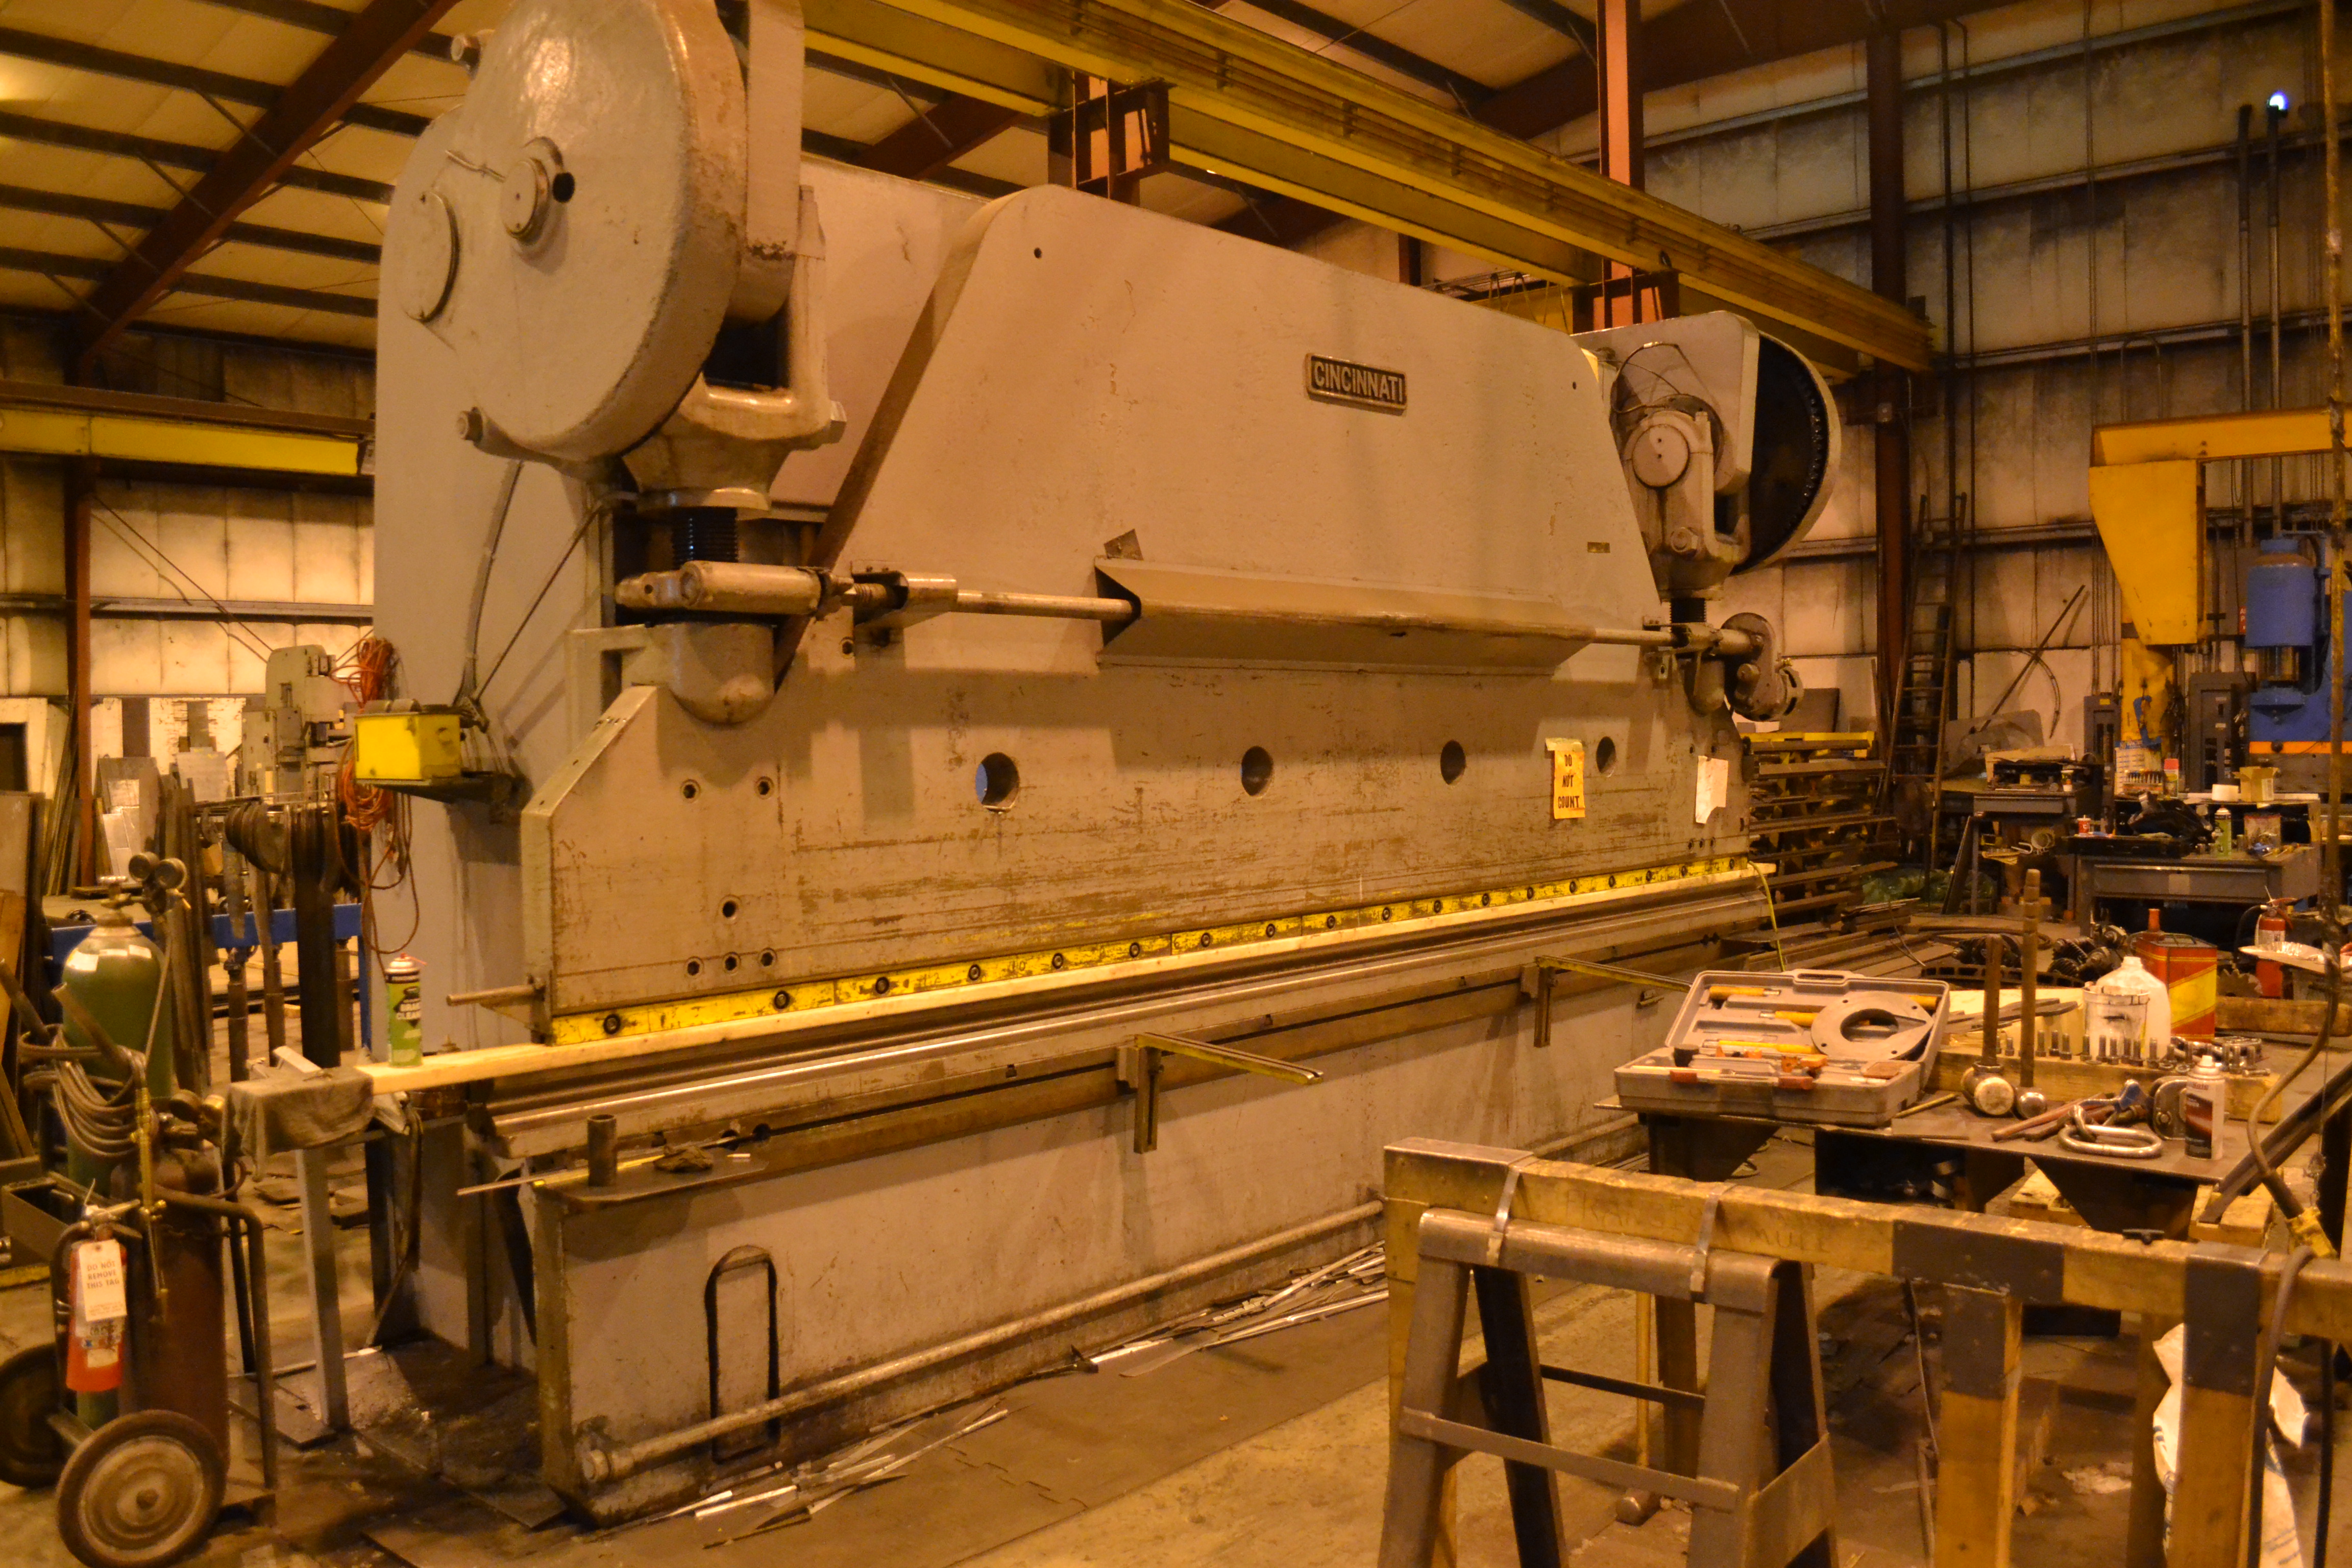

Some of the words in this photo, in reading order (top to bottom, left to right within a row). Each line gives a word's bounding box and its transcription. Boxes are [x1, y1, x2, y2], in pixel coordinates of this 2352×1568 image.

[1314, 361, 1403, 403] CINCINNATI
[1564, 754, 1572, 767] DO
[1562, 774, 1574, 788] NOT
[1558, 795, 1579, 809] COUNT
[101, 1259, 115, 1269] NOT
[88, 1269, 116, 1280] REMOVE
[87, 1281, 103, 1289] THIS
[106, 1278, 120, 1286] TAG
